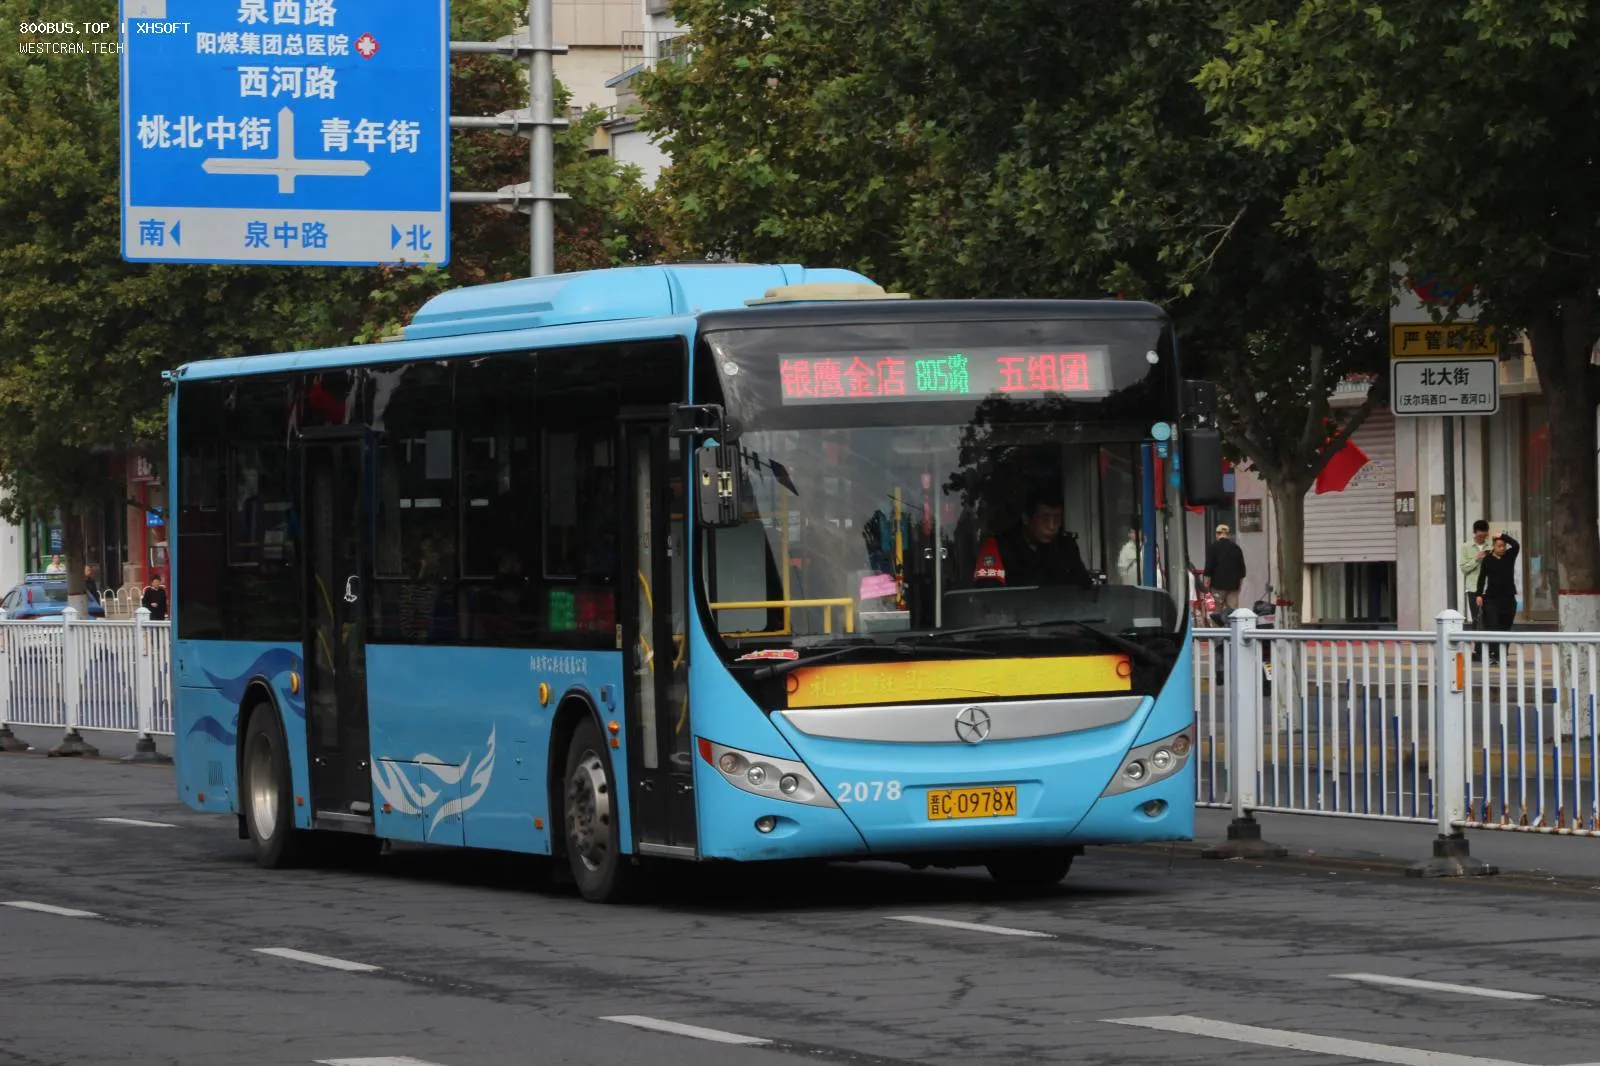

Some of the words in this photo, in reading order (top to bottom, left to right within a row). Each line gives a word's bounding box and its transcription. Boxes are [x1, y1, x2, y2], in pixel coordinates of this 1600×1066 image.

[238, 0, 336, 27] 泉西路
[196, 32, 350, 57] 阳煤集团总医院
[237, 65, 338, 100] 西河路
[137, 115, 272, 150] 桃北中街
[319, 117, 421, 153] 青年街
[138, 219, 166, 247] 南
[244, 221, 329, 249] 泉中路
[406, 224, 432, 251] 北
[780, 357, 906, 397] 银鹰金店
[996, 352, 1090, 392] 五组团
[1420, 367, 1469, 386] 北大街
[837, 780, 902, 803] 2078
